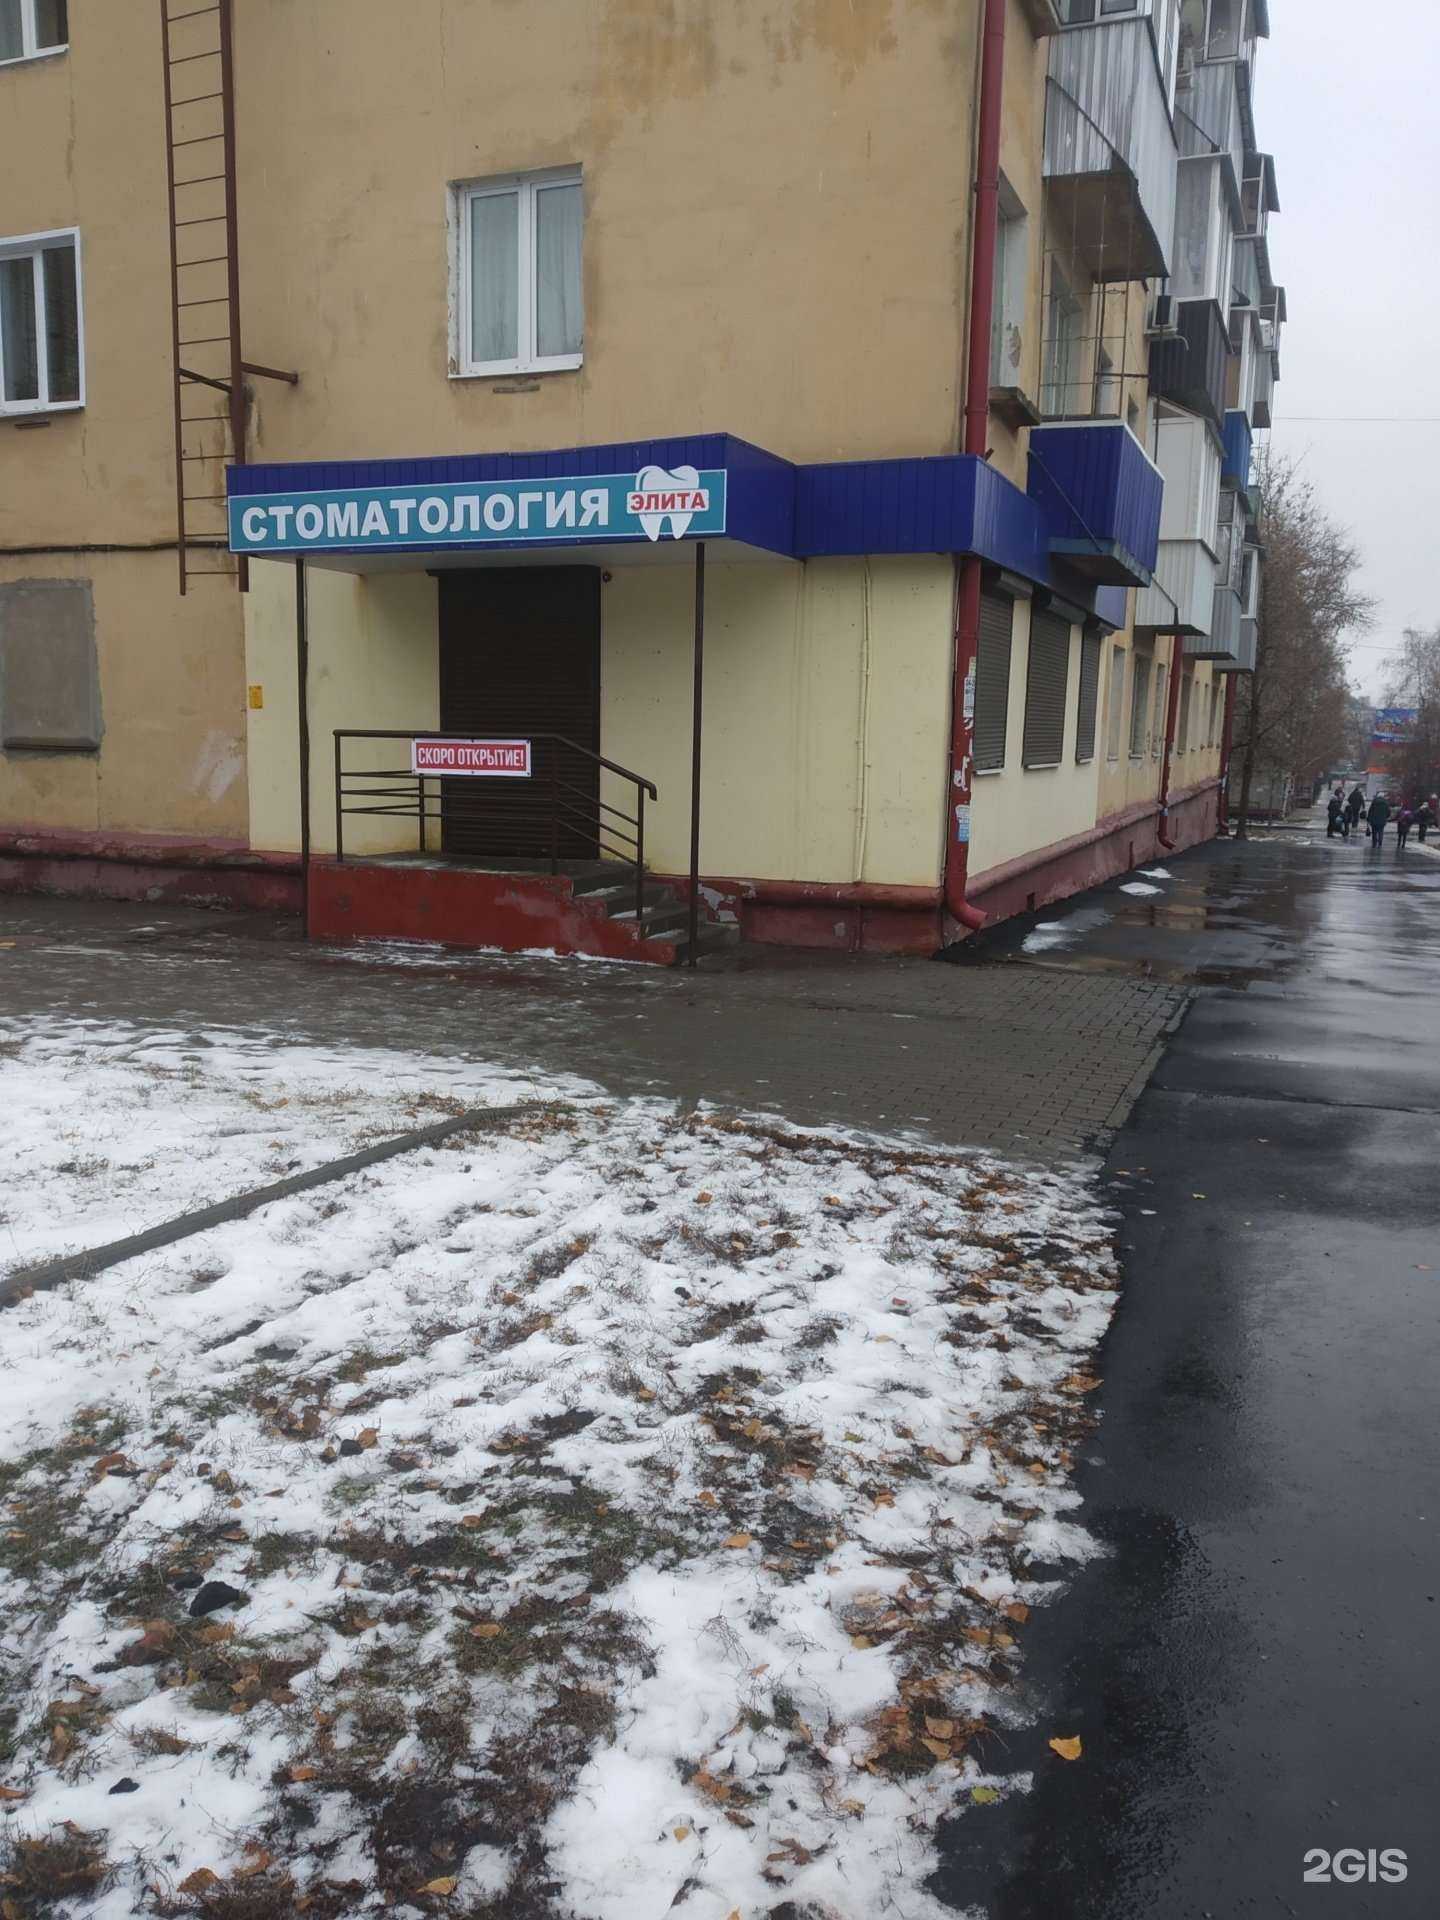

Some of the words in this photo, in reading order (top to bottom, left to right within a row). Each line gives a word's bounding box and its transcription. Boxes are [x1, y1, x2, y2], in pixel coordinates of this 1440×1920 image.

[630, 491, 706, 512] ЭЛИТА
[242, 488, 609, 542] СТОМАТОЛОГИЯ
[418, 747, 455, 765] СКОРО
[457, 748, 524, 767] ОТКРЫТИЕ!
